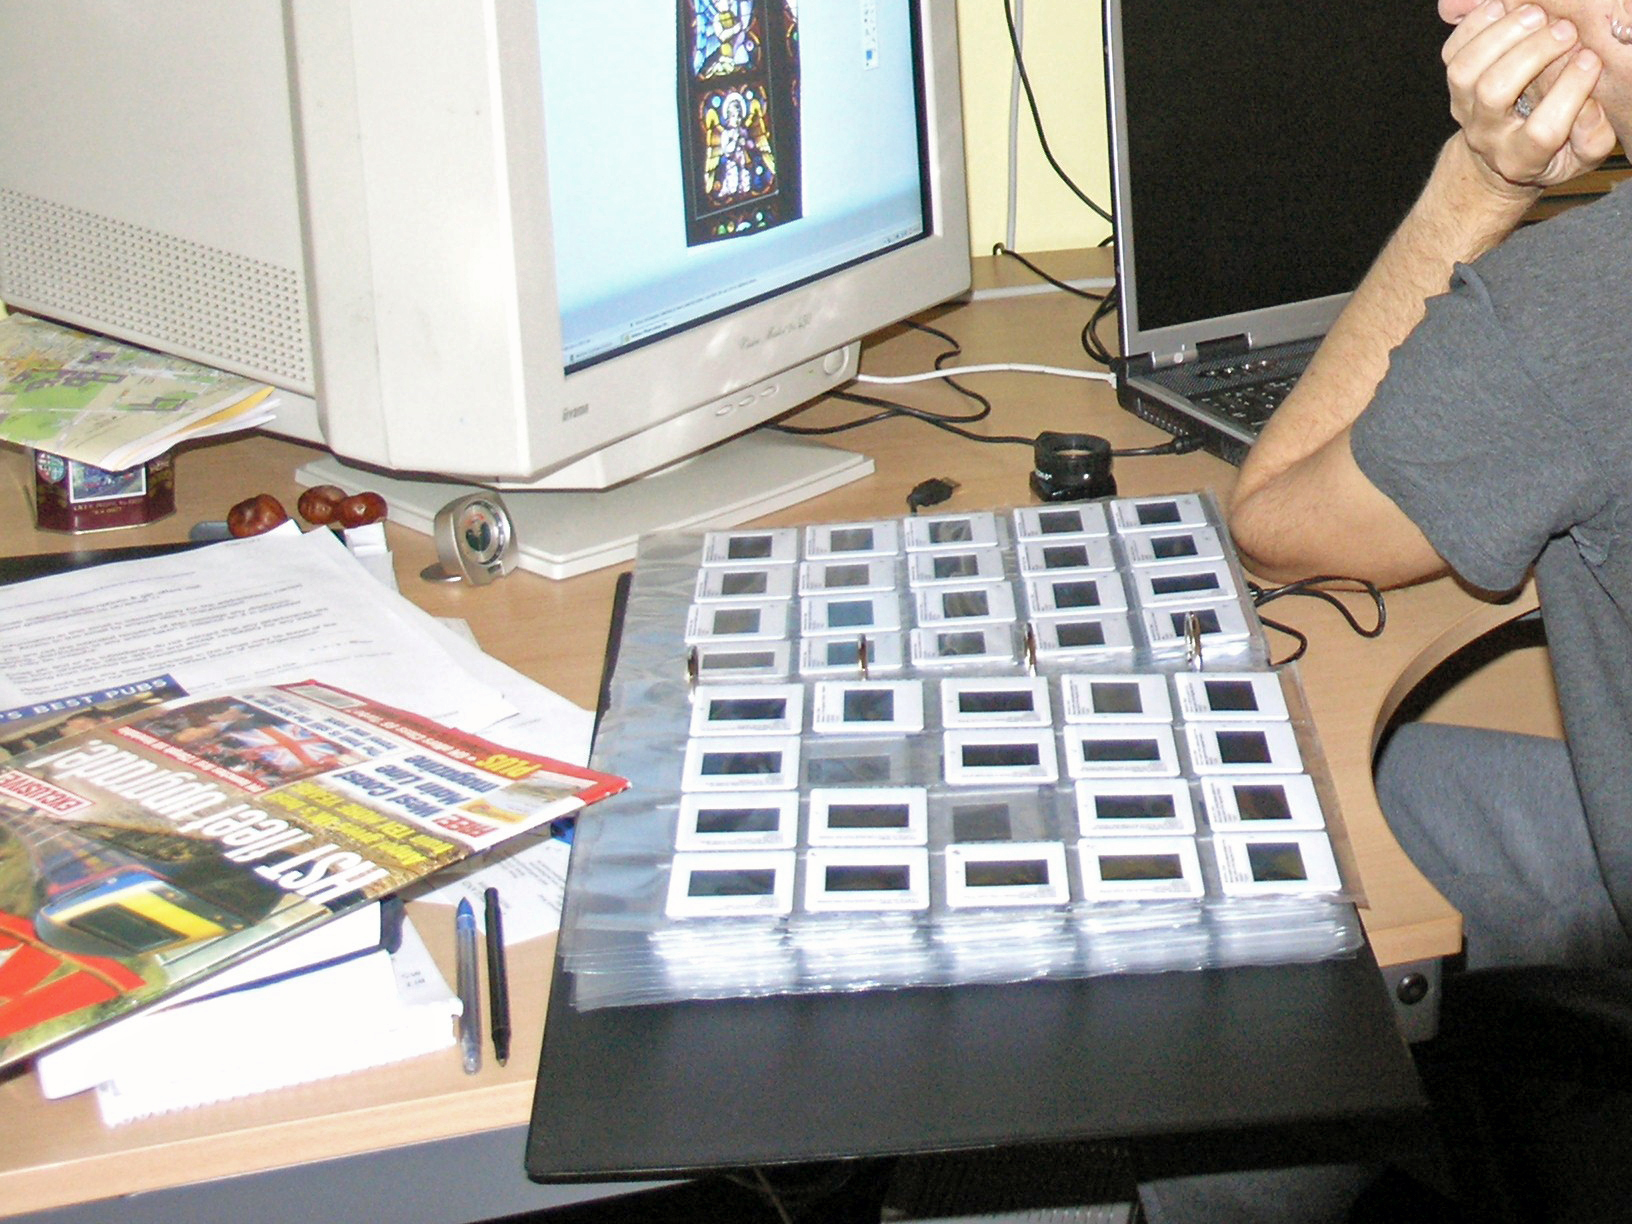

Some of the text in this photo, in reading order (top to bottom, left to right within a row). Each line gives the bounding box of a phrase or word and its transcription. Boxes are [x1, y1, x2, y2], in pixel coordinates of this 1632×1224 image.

[33, 693, 94, 716] BEST
[104, 677, 169, 701] PUBS
[25, 739, 226, 820] upgrade!
[368, 763, 469, 805] Main Line
[401, 756, 499, 792] magazine
[473, 753, 541, 777] PLUS
[331, 770, 494, 837] FREE! West Coast
[177, 803, 313, 862] fleet
[254, 843, 391, 905] HST
